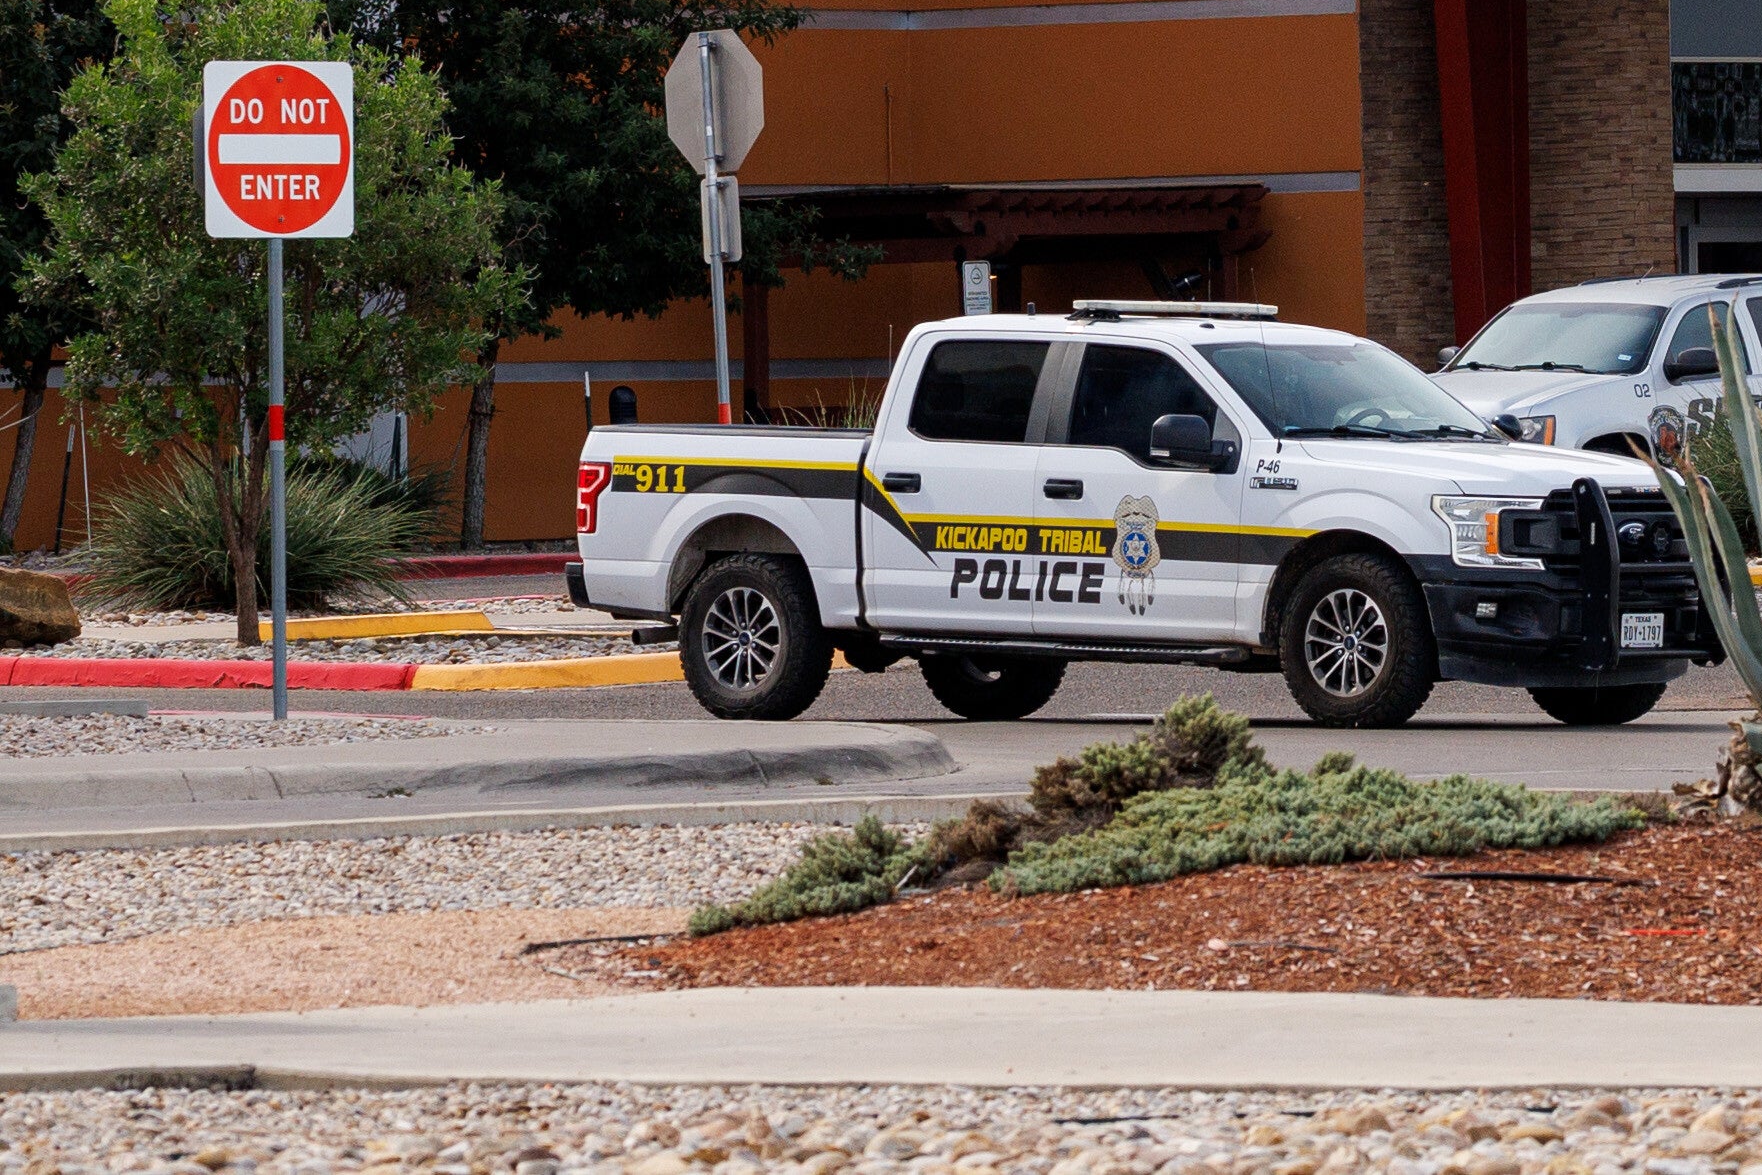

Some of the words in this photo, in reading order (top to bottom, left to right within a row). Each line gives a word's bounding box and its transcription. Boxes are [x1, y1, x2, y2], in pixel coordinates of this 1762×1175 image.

[229, 97, 264, 125] DO
[280, 97, 330, 125] NOT
[240, 173, 321, 201] ENTER
[612, 463, 636, 476] DIAL
[635, 464, 687, 493] 911
[1255, 458, 1282, 474] P-46
[935, 525, 1028, 552] KICKAPOO
[1038, 528, 1107, 555] TRIBAL
[949, 557, 1106, 604] POLICE
[1634, 615, 1652, 623] TEXAS
